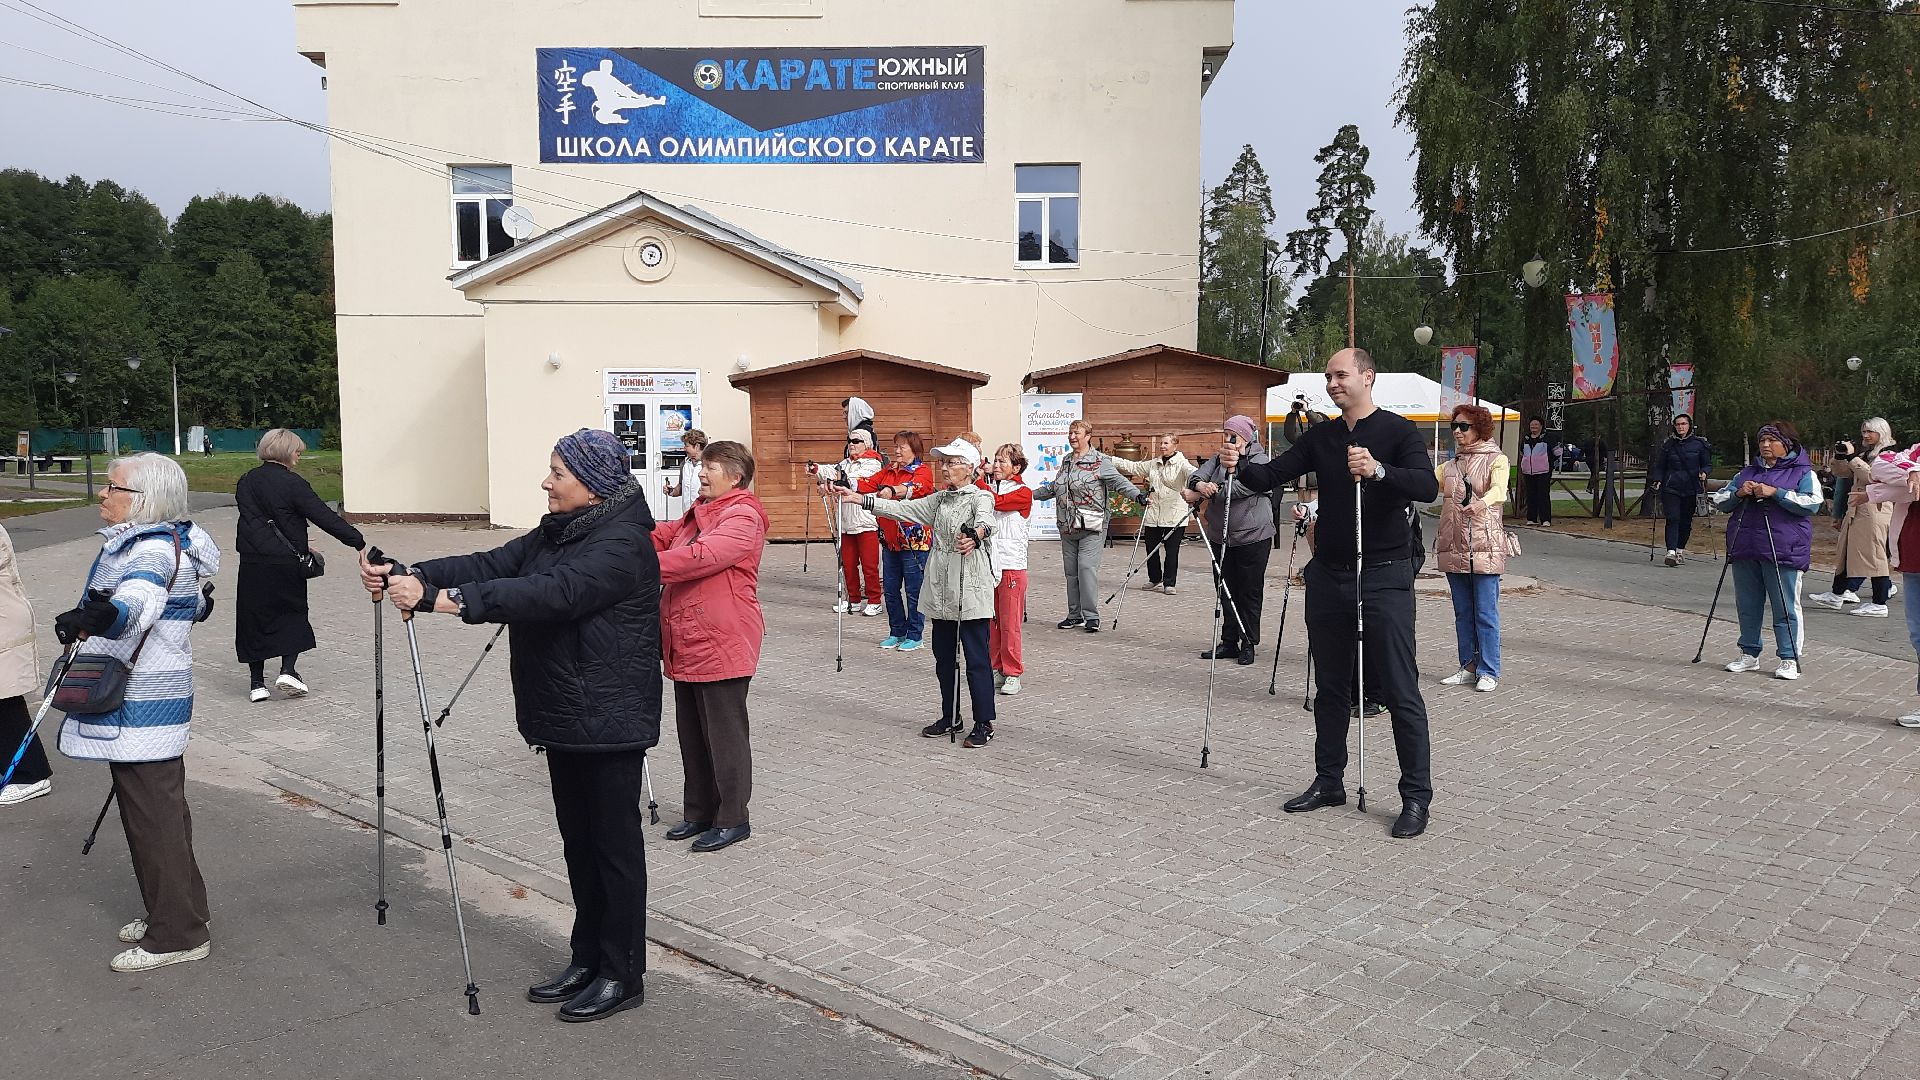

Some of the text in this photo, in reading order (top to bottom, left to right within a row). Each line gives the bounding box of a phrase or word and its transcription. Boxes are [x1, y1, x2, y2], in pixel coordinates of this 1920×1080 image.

[724, 59, 876, 91] КАРАТЕ
[878, 53, 967, 76] ЮЖНЫЙ
[555, 60, 577, 124] 空手
[877, 80, 965, 90] СПОРТИВНЫЙ КЛУБ
[556, 132, 974, 157] ШКОЛА ОЛИМПИЙСКОГО КАРАТЕ
[619, 376, 654, 387] ЮЖНЫЙ
